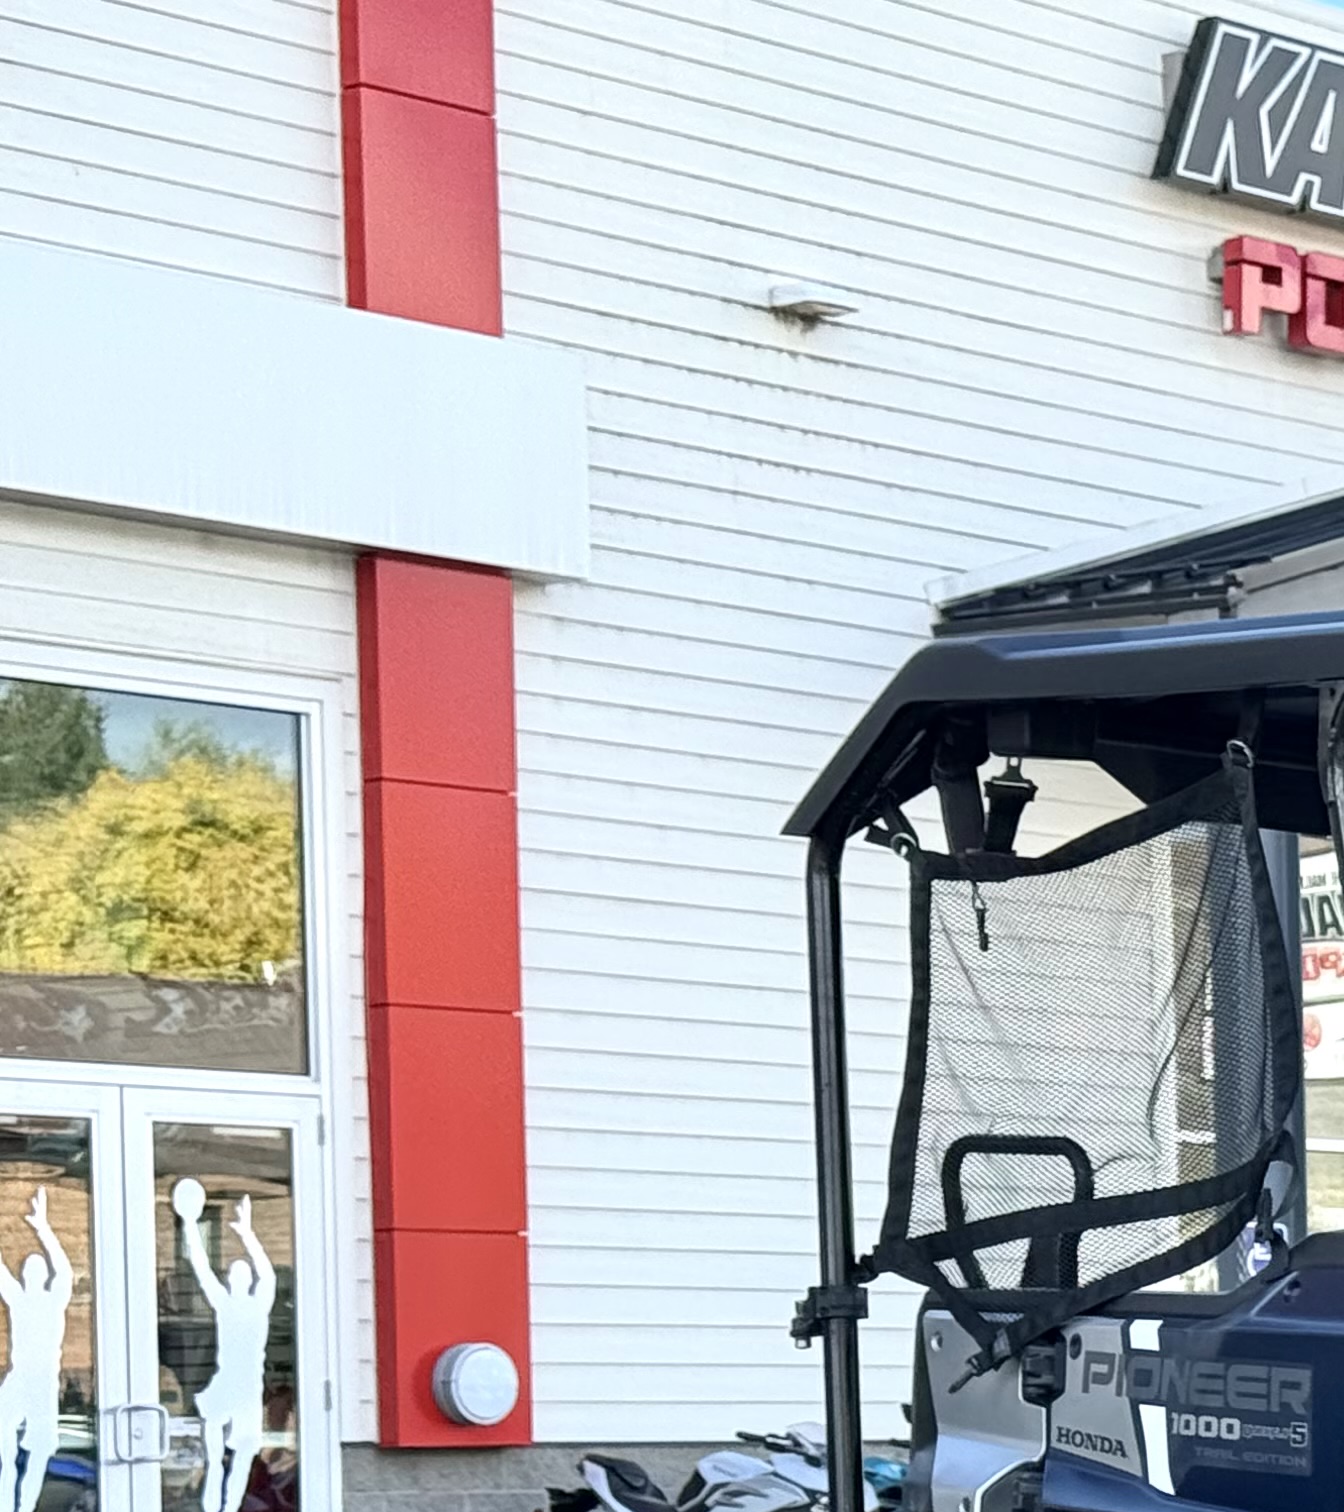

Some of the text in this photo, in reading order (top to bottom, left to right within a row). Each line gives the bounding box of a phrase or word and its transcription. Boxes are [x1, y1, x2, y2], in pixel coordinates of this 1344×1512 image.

[1081, 1350, 1313, 1416] PIONEER
[1170, 1411, 1242, 1441] 1000
[1055, 1425, 1130, 1460] HONDA
[1241, 1451, 1309, 1470] EDITION
